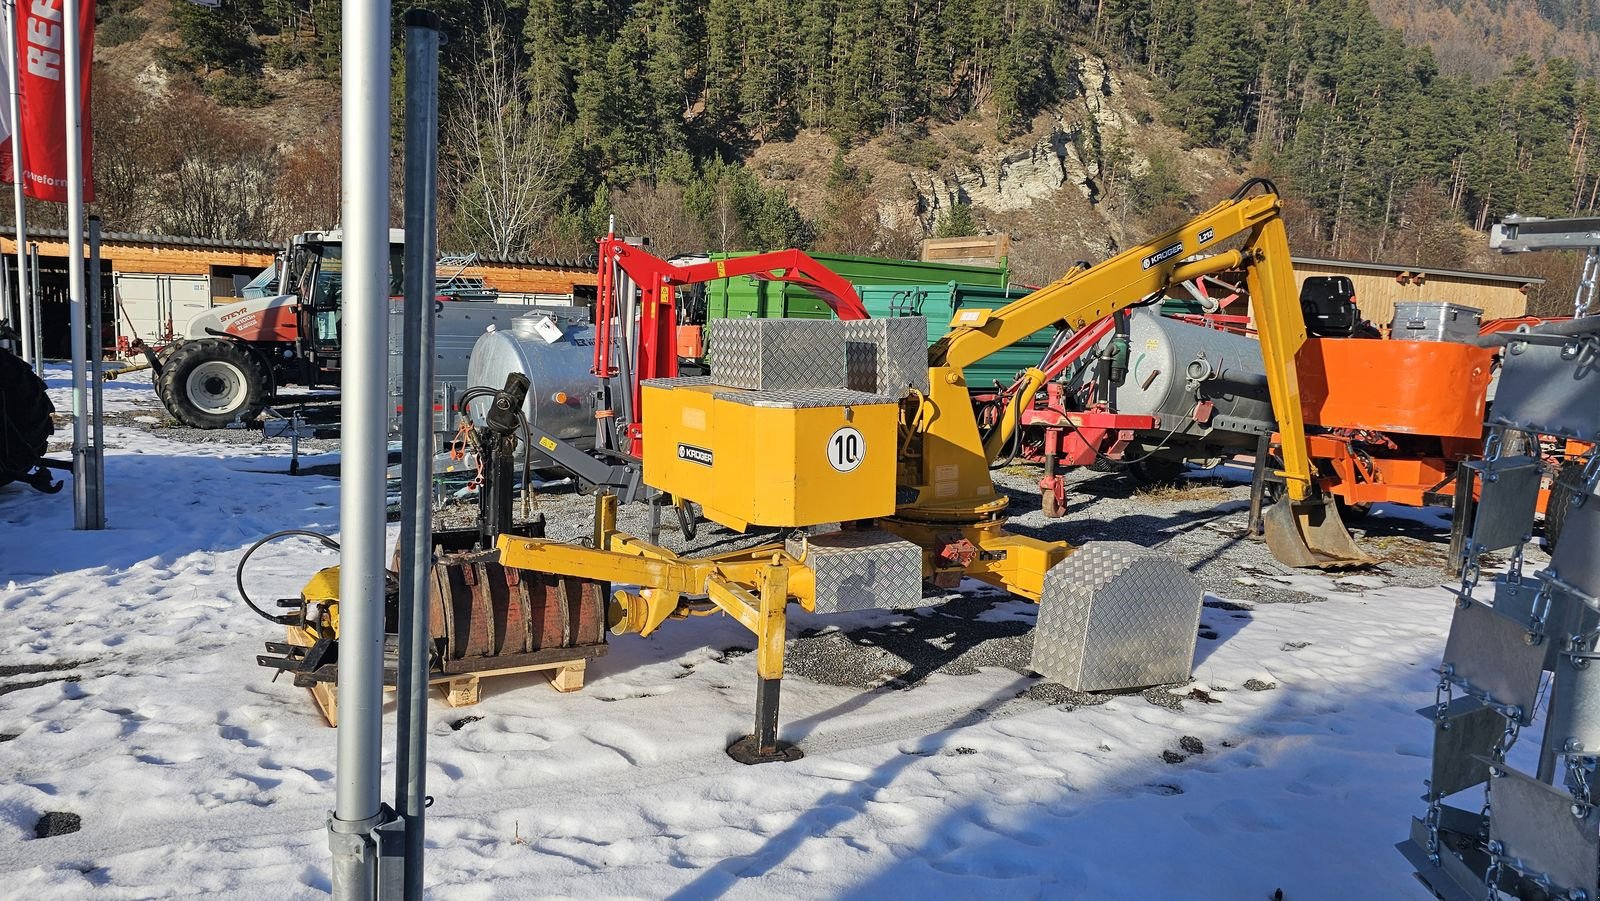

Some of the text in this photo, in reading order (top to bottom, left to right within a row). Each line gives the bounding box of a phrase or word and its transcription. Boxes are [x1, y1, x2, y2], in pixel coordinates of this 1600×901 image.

[1199, 230, 1214, 242] L212
[220, 307, 248, 323] STEYR
[835, 434, 857, 465] 10
